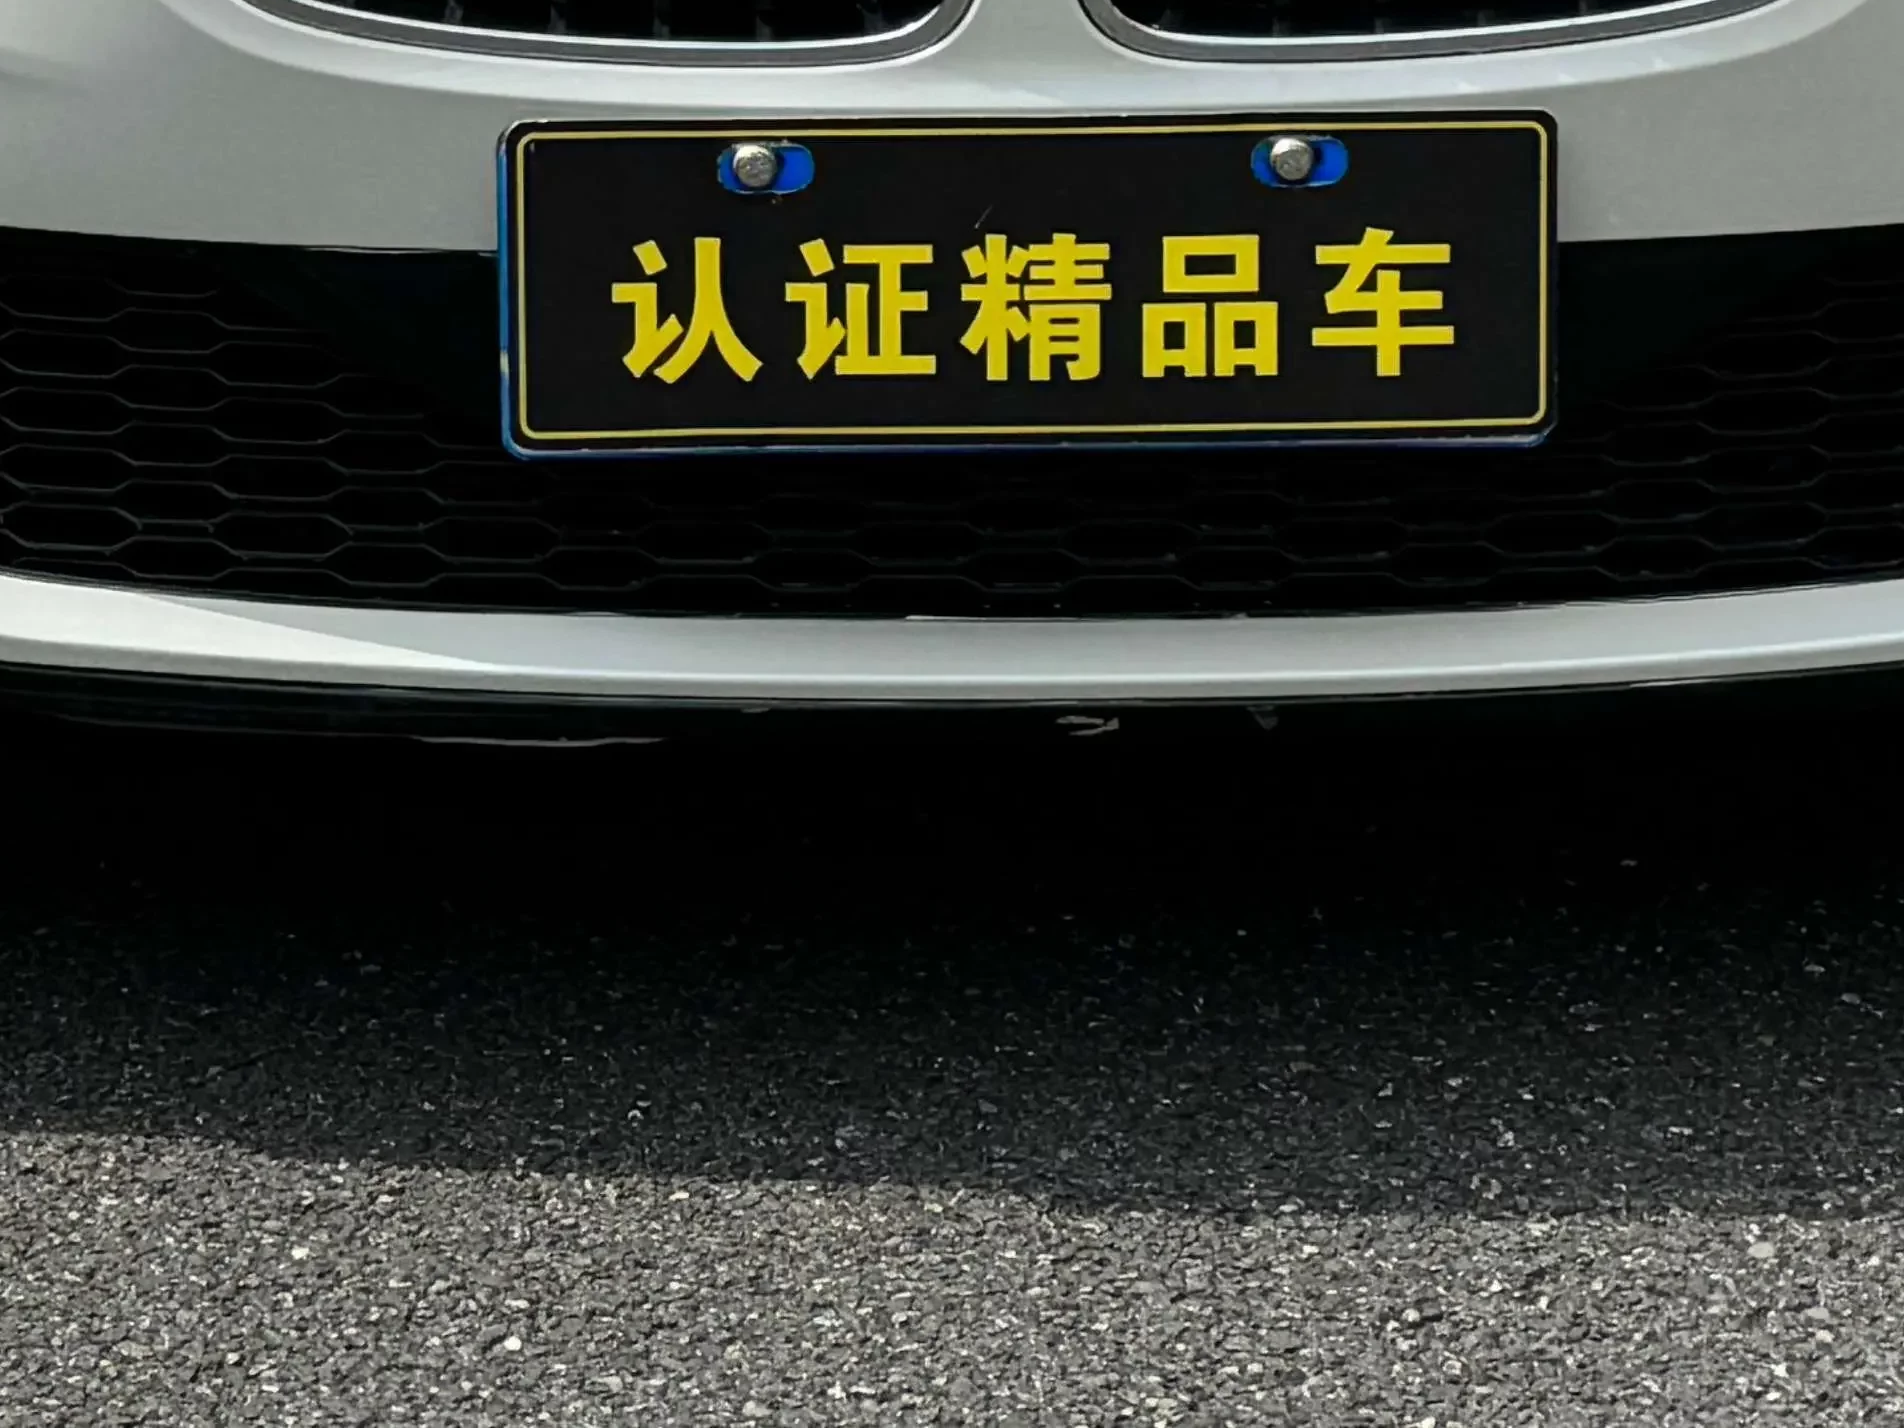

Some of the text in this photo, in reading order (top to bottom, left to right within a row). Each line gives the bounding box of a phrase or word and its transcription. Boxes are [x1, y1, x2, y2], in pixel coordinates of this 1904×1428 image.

[610, 227, 1457, 384] 认证精品车
